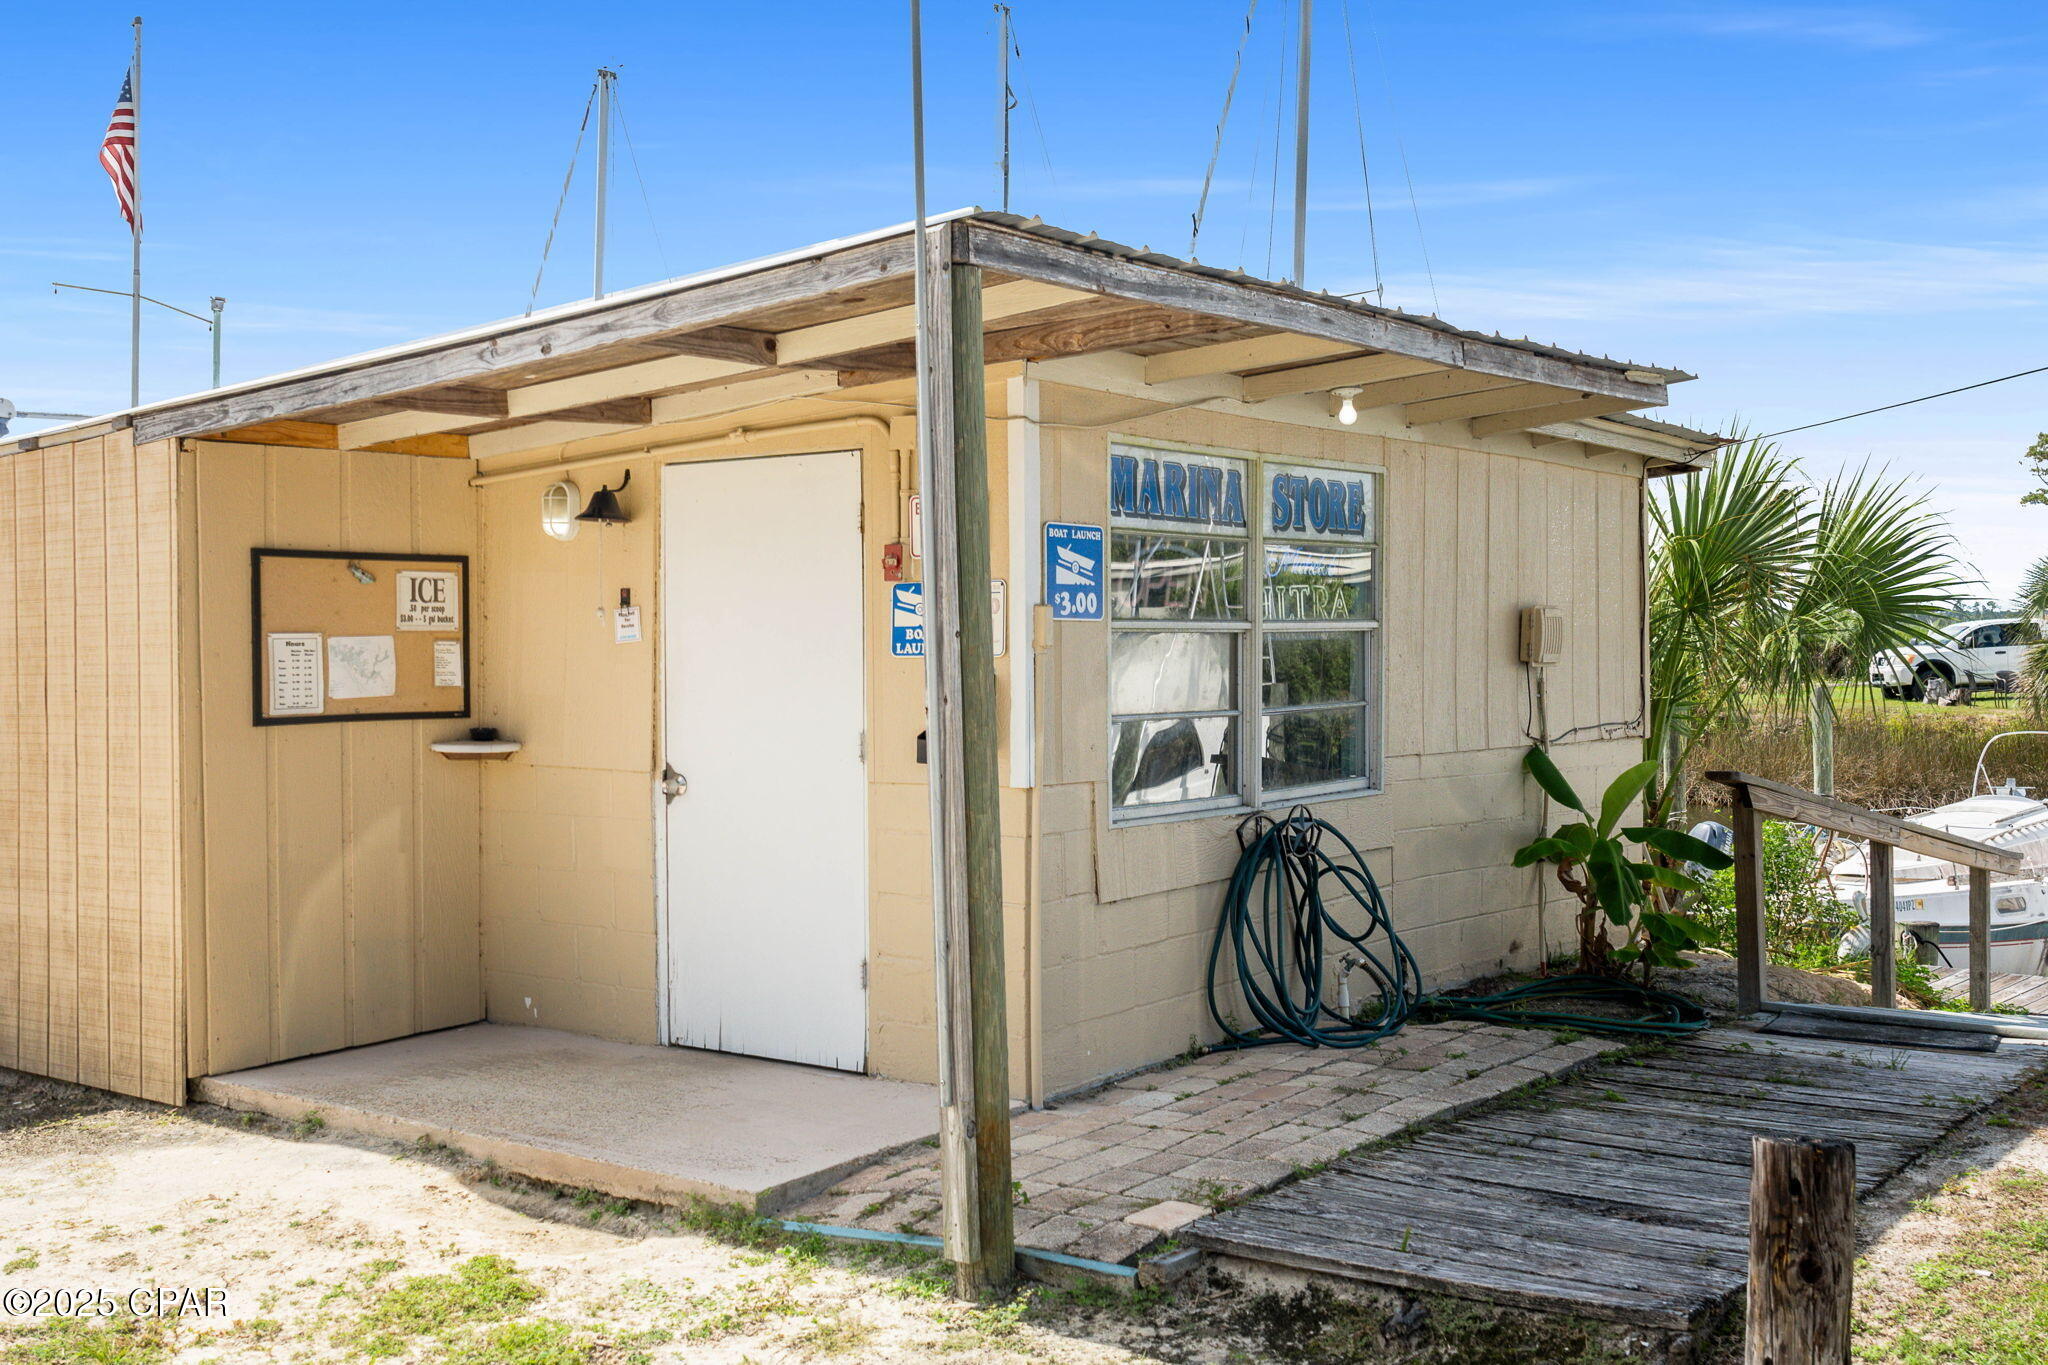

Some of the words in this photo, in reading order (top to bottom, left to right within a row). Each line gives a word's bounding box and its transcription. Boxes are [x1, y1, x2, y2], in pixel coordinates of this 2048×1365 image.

[1111, 454, 1246, 527] MARINA
[1272, 473, 1366, 537] STORE
[1048, 527, 1068, 538] BOAT
[1071, 528, 1102, 541] LAUNCH
[409, 577, 446, 603] ICE
[421, 606, 430, 615] per
[431, 606, 446, 615] scoop
[1055, 591, 1098, 616] $3.00
[905, 628, 924, 640] BO
[896, 642, 925, 654] LAU
